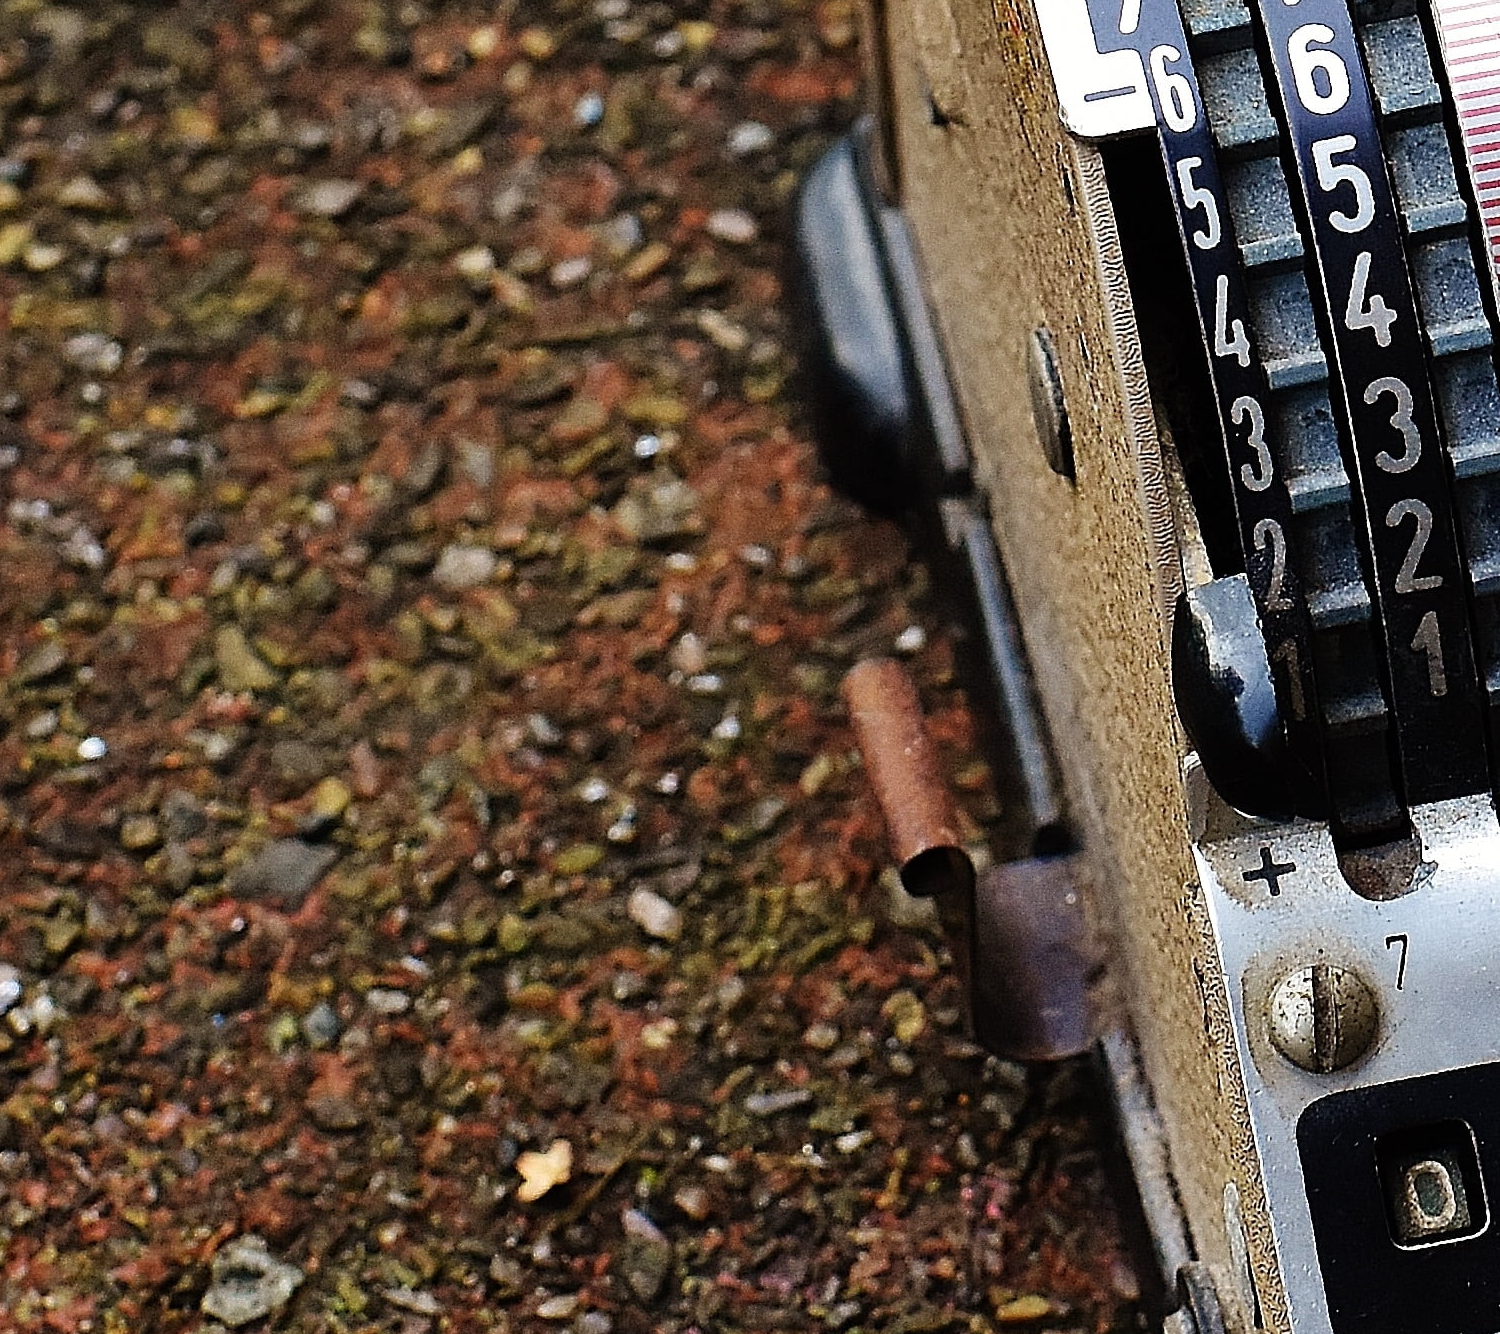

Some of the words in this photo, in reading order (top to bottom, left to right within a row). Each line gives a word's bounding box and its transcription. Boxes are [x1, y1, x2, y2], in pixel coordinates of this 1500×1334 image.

[1149, 45, 1197, 133] 6
[1286, 23, 1350, 115] 6
[1176, 157, 1221, 249] 5
[1311, 134, 1376, 233] 5
[1215, 274, 1251, 369] 4
[1344, 252, 1398, 347] 4
[1231, 397, 1273, 493] 3
[1363, 376, 1421, 474] 3
[1385, 498, 1444, 594] 2
[1410, 610, 1447, 697] 1
[1385, 934, 1408, 991] 7
